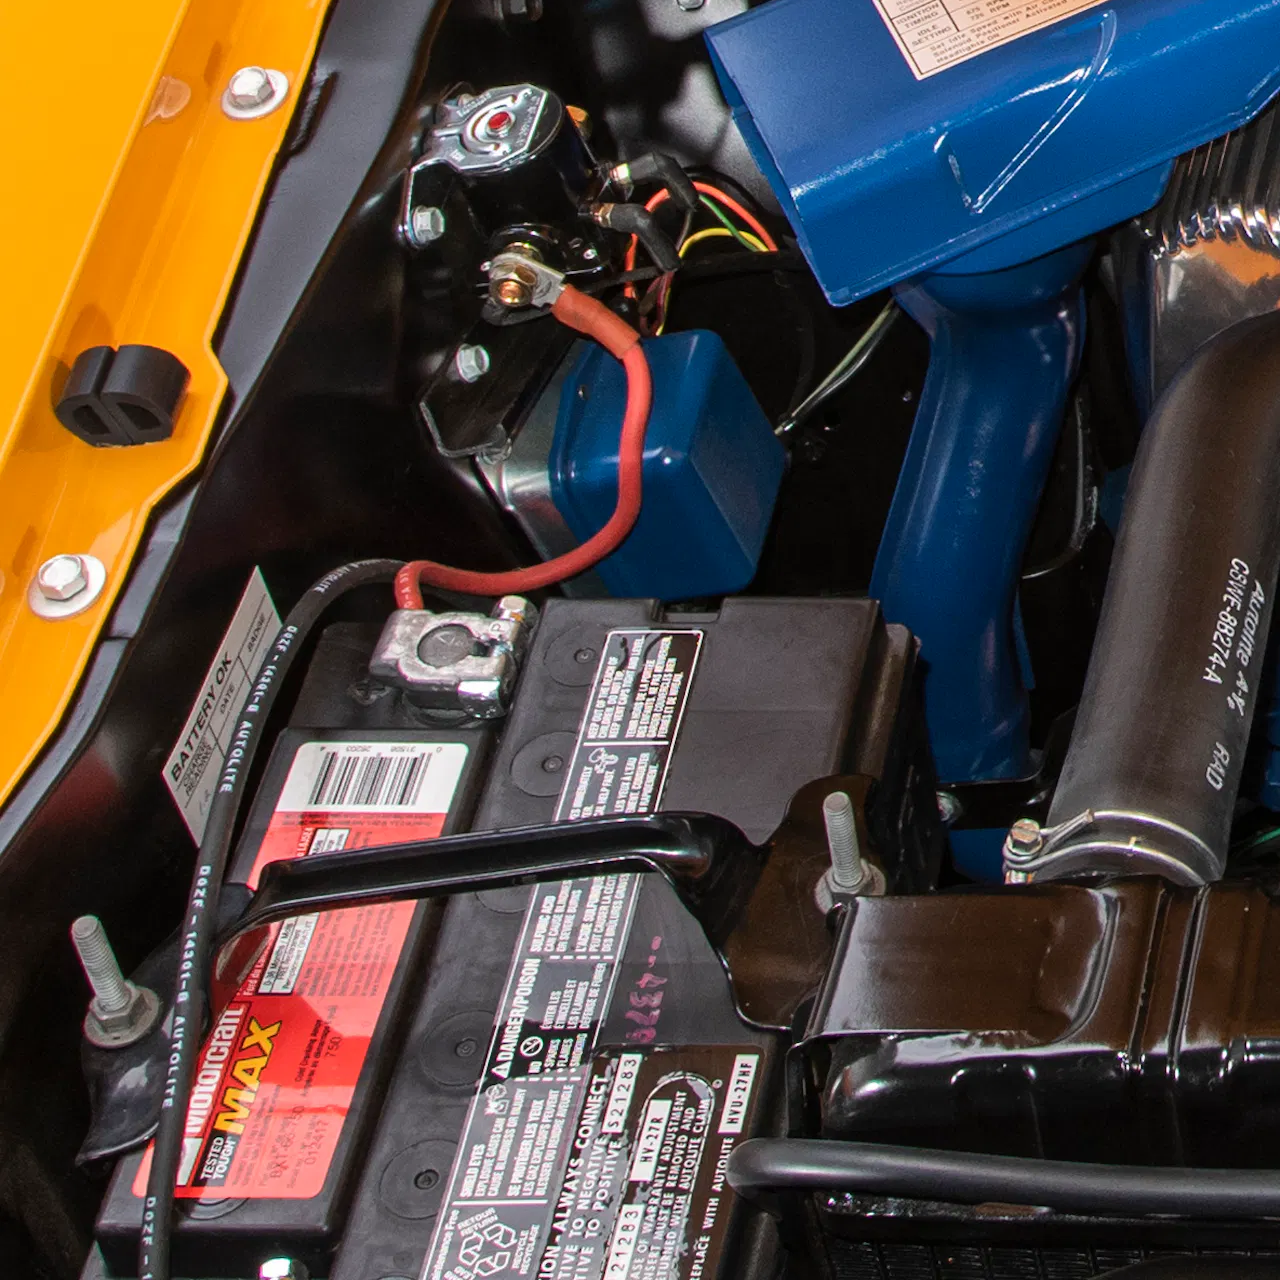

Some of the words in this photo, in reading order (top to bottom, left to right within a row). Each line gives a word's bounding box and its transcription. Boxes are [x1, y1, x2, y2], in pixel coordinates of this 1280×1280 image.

[216, 683, 238, 714] DATE
[167, 687, 217, 781] BATTERY
[210, 651, 235, 685] OK
[214, 719, 258, 796] AUTOLITE
[1205, 741, 1230, 791] RAD
[597, 788, 610, 801] HELP
[529, 915, 551, 951] SULFURIC
[540, 895, 556, 913] ACID
[548, 914, 563, 935] CAUSE
[543, 937, 557, 951] CAN
[555, 941, 567, 951] OR
[565, 979, 577, 987] ET
[590, 962, 607, 986] FUMER
[547, 991, 561, 1003] LES
[570, 980, 590, 1014] FLAMMES
[587, 987, 600, 997] DE
[496, 958, 541, 1060] DANGER/POISON
[567, 1015, 580, 1028] LES
[161, 1015, 185, 1110] AUTOLITE
[527, 1061, 542, 1073] NO
[556, 1038, 574, 1066] FLAMES
[182, 1004, 243, 1134] Motorcraft
[212, 1016, 281, 1134] MAX
[508, 1088, 526, 1114] INJURY
[527, 1099, 544, 1121] YEUX
[540, 1089, 560, 1122] PEUVENT
[554, 1083, 574, 1117] AVEUGLE
[492, 1117, 505, 1132] CAN
[505, 1116, 518, 1127] OR
[522, 1123, 538, 1137] LES
[679, 1106, 697, 1131] AND
[692, 1098, 711, 1133] CLAIM
[484, 1133, 501, 1157] GASES
[493, 1128, 515, 1169] BLINDNESS
[529, 1123, 550, 1163] EXPLOSIFS
[546, 1119, 565, 1148] RENDRE
[637, 1113, 666, 1165] HV-27R
[199, 1134, 225, 1180] TESTED
[212, 1137, 236, 1180] TOUGH
[467, 1144, 486, 1165] EYES
[507, 1138, 534, 1183] PROTÉGER
[542, 1149, 556, 1160] OU
[552, 1157, 585, 1231] ALWAYS
[573, 1075, 608, 1150] CONNECT
[640, 1165, 668, 1234] WARRANTY
[658, 1091, 687, 1160] ADJUSTMENT
[665, 1134, 689, 1187] REMOVED
[677, 1137, 701, 1189] AUTOLITE
[459, 1167, 479, 1196] SHIELD
[474, 1158, 494, 1195] EXPLOSIVE
[486, 1171, 503, 1195] CAUSE
[524, 1164, 539, 1179] GAZ
[533, 1162, 553, 1195] BLESSER
[573, 1136, 610, 1211] NEGATIVE
[589, 1140, 624, 1211] POSITIVE
[702, 1198, 719, 1229] WITH
[712, 1138, 735, 1190] AUTOLITE
[506, 1184, 521, 1195] SE
[520, 1180, 535, 1195] LES
[659, 1191, 675, 1207] BE
[443, 1209, 460, 1230] Free
[653, 1209, 669, 1239] MUST
[668, 1194, 687, 1226] WITH
[568, 1216, 587, 1239] TO
[582, 1217, 602, 1240] TO
[510, 1229, 529, 1269] RECYCLE
[517, 1224, 541, 1273] RECYCLAGE
